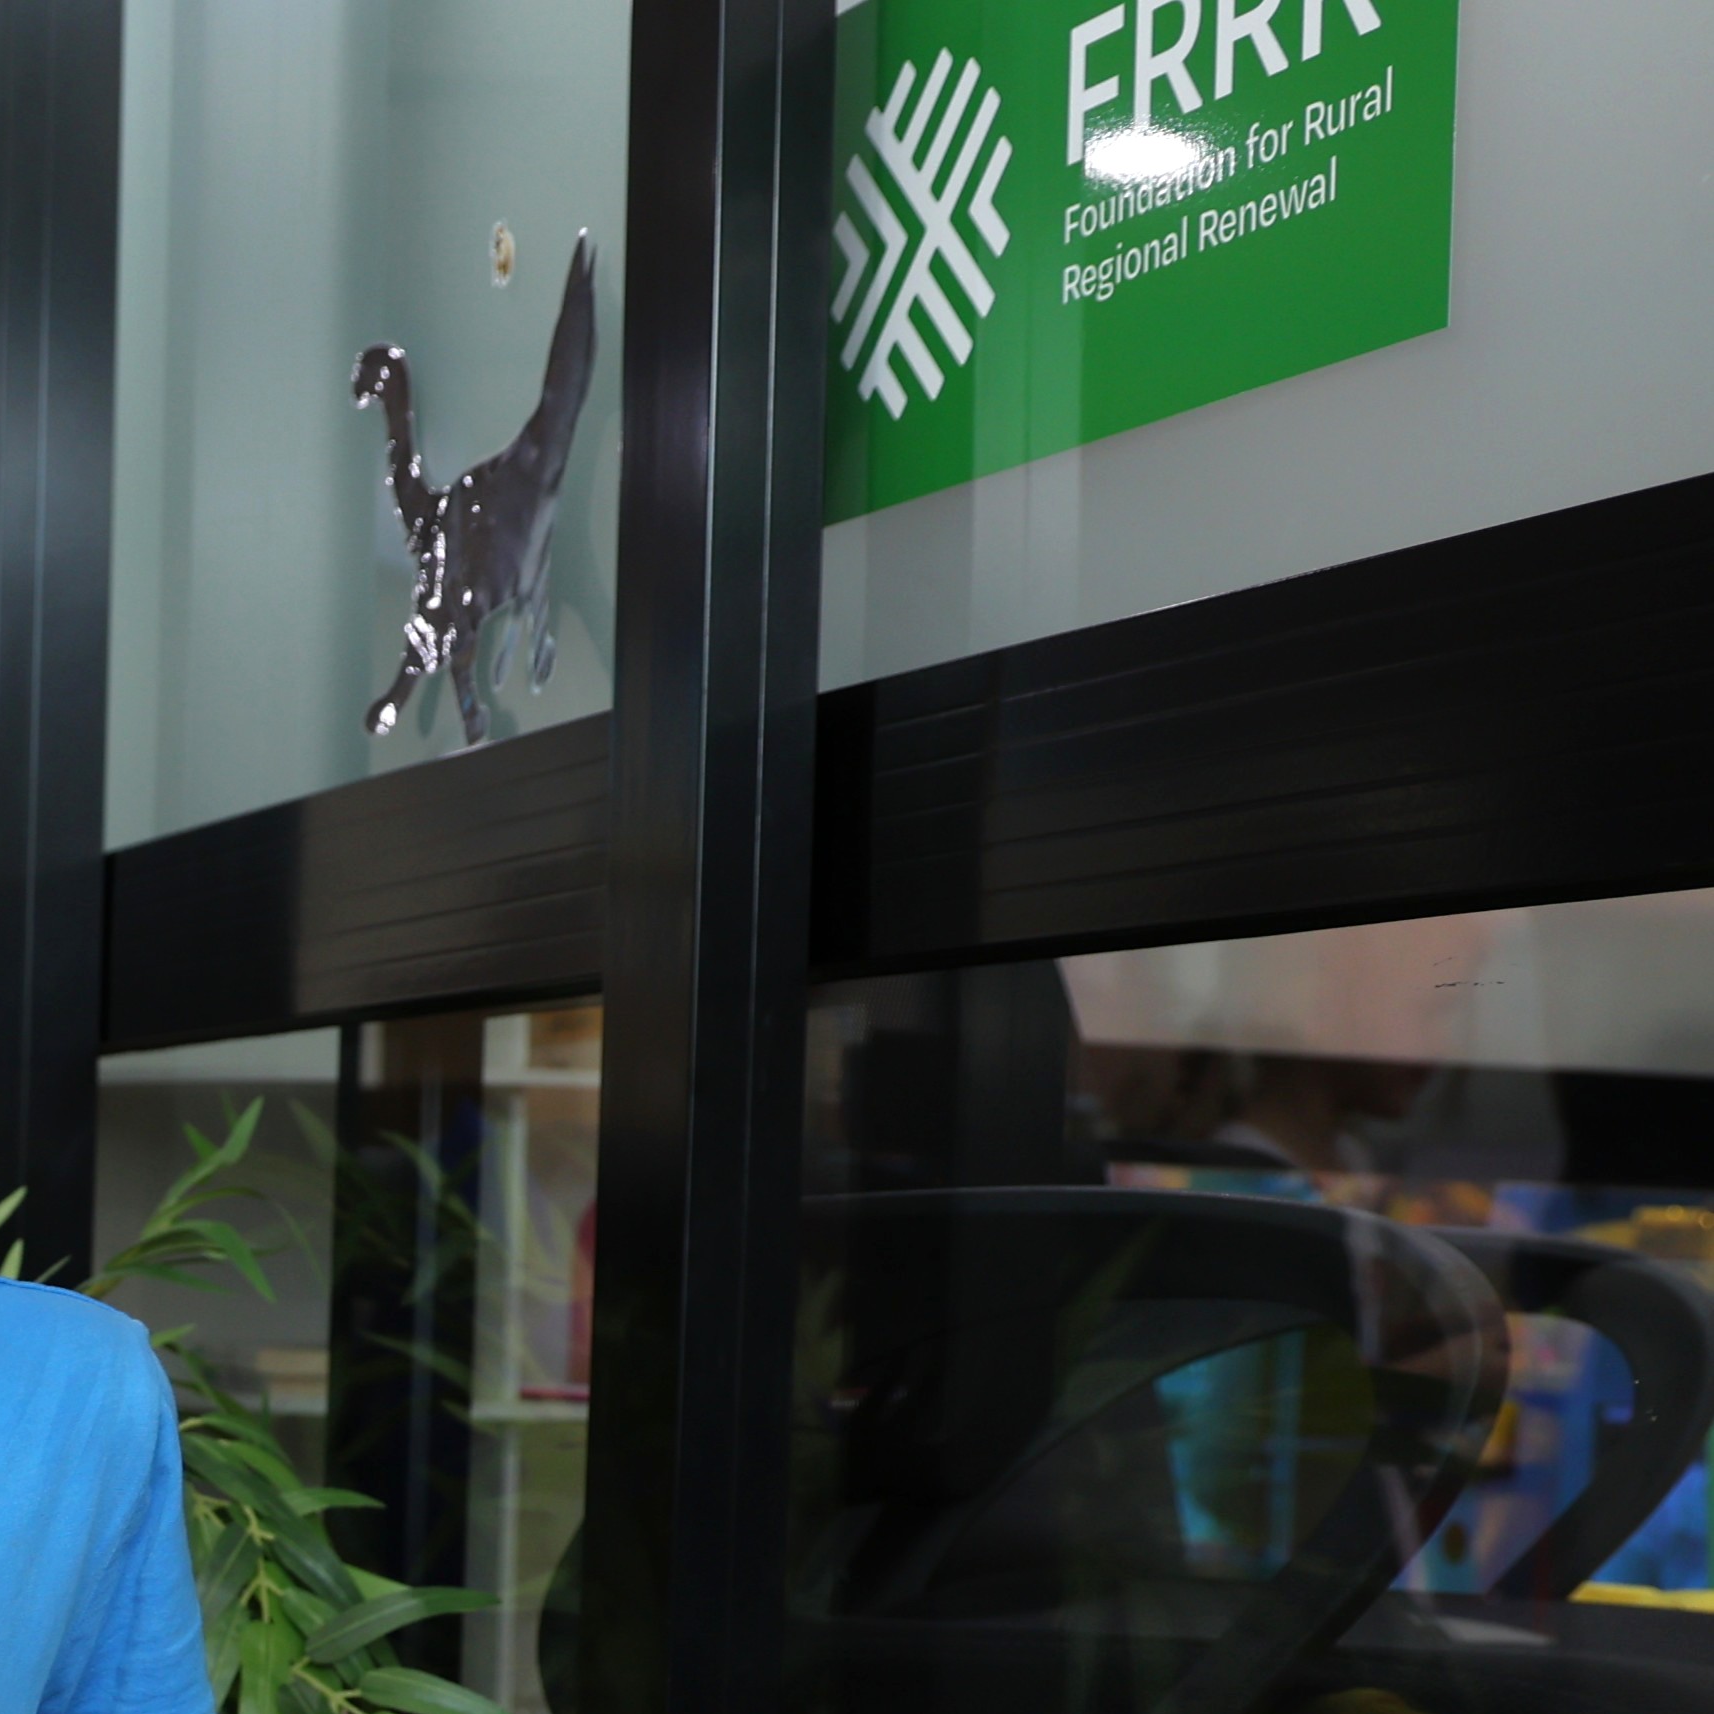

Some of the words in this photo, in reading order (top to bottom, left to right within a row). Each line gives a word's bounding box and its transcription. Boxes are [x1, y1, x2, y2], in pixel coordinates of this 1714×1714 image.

[1061, 214, 1189, 304] Regional
[1198, 154, 1338, 252] Renewal
[1064, 145, 1236, 244] Foundation
[1245, 121, 1294, 169] for
[1304, 64, 1394, 146] Rural
